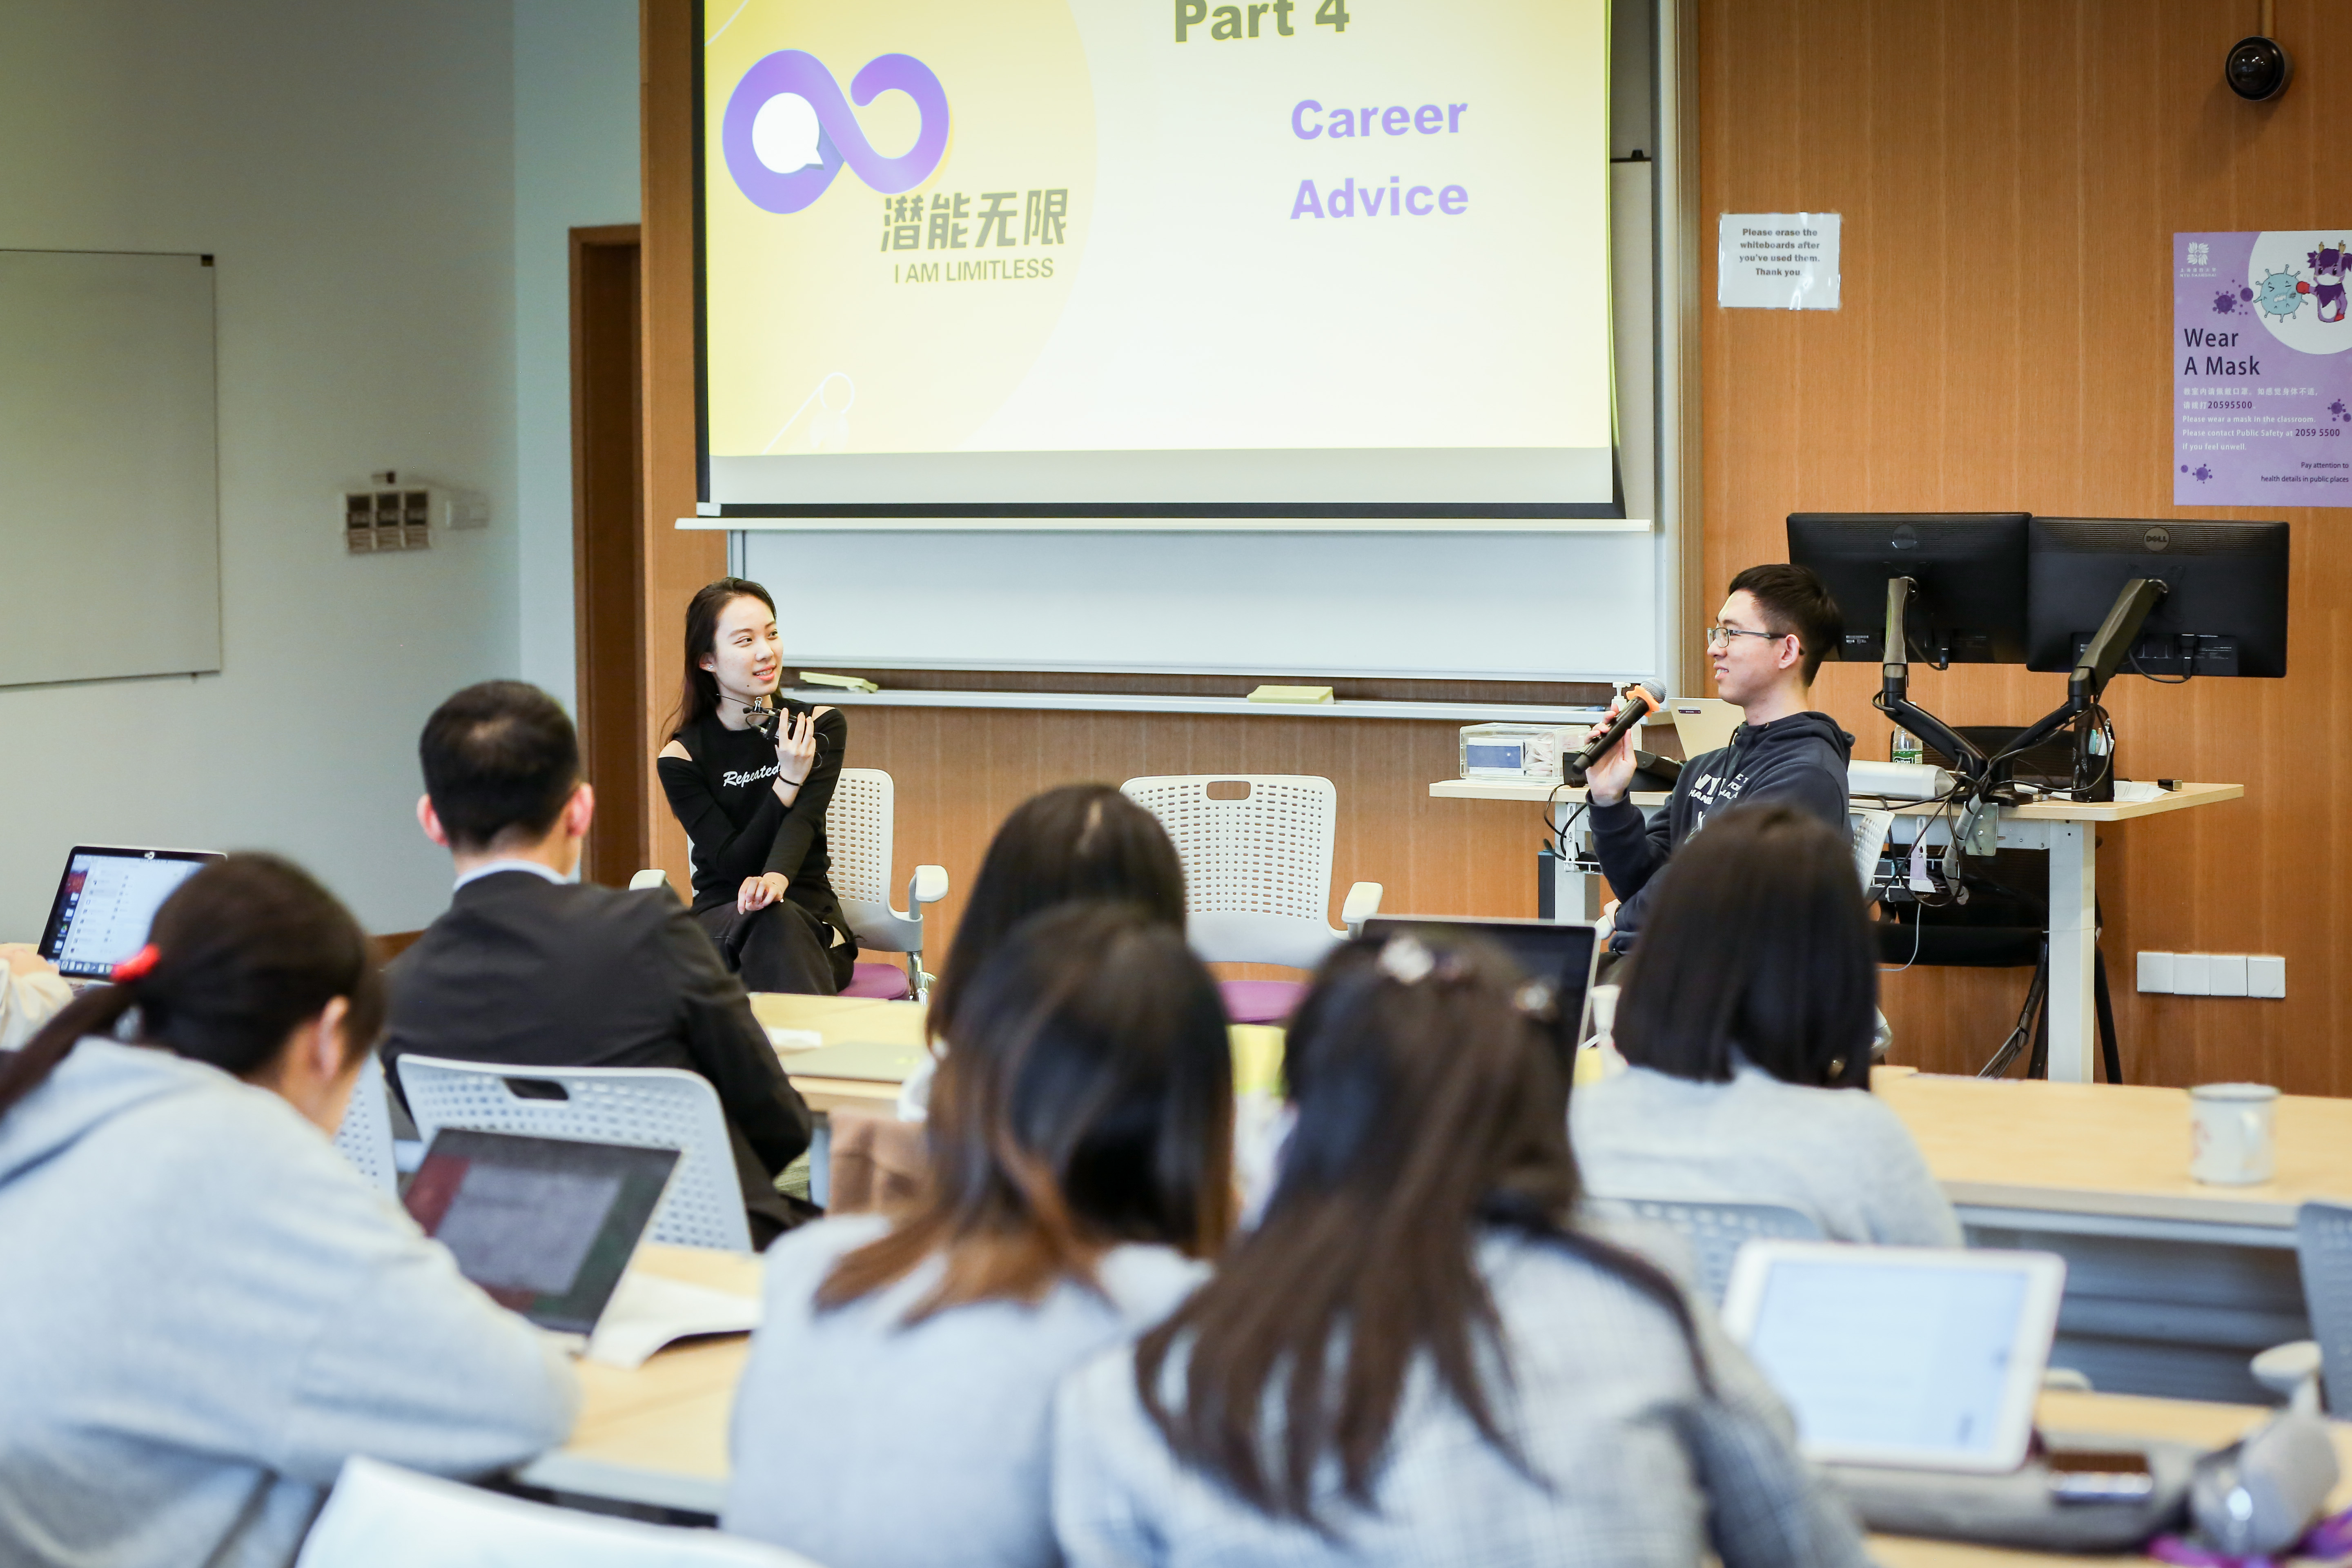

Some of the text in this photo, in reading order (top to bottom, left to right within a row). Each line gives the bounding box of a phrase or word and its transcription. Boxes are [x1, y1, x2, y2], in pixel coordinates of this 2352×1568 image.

[1176, 0, 1349, 42] Part 4
[1292, 100, 1468, 140] Career
[1290, 176, 1469, 220] Advice
[881, 189, 1068, 252] 潜能无限
[895, 258, 1054, 283] I AM LIMITLESS
[1740, 254, 1768, 262] you've
[2184, 328, 2239, 347] Wear
[2184, 355, 2261, 376] A Mask
[2261, 429, 2284, 438] Safety
[723, 761, 781, 788] Repeated
